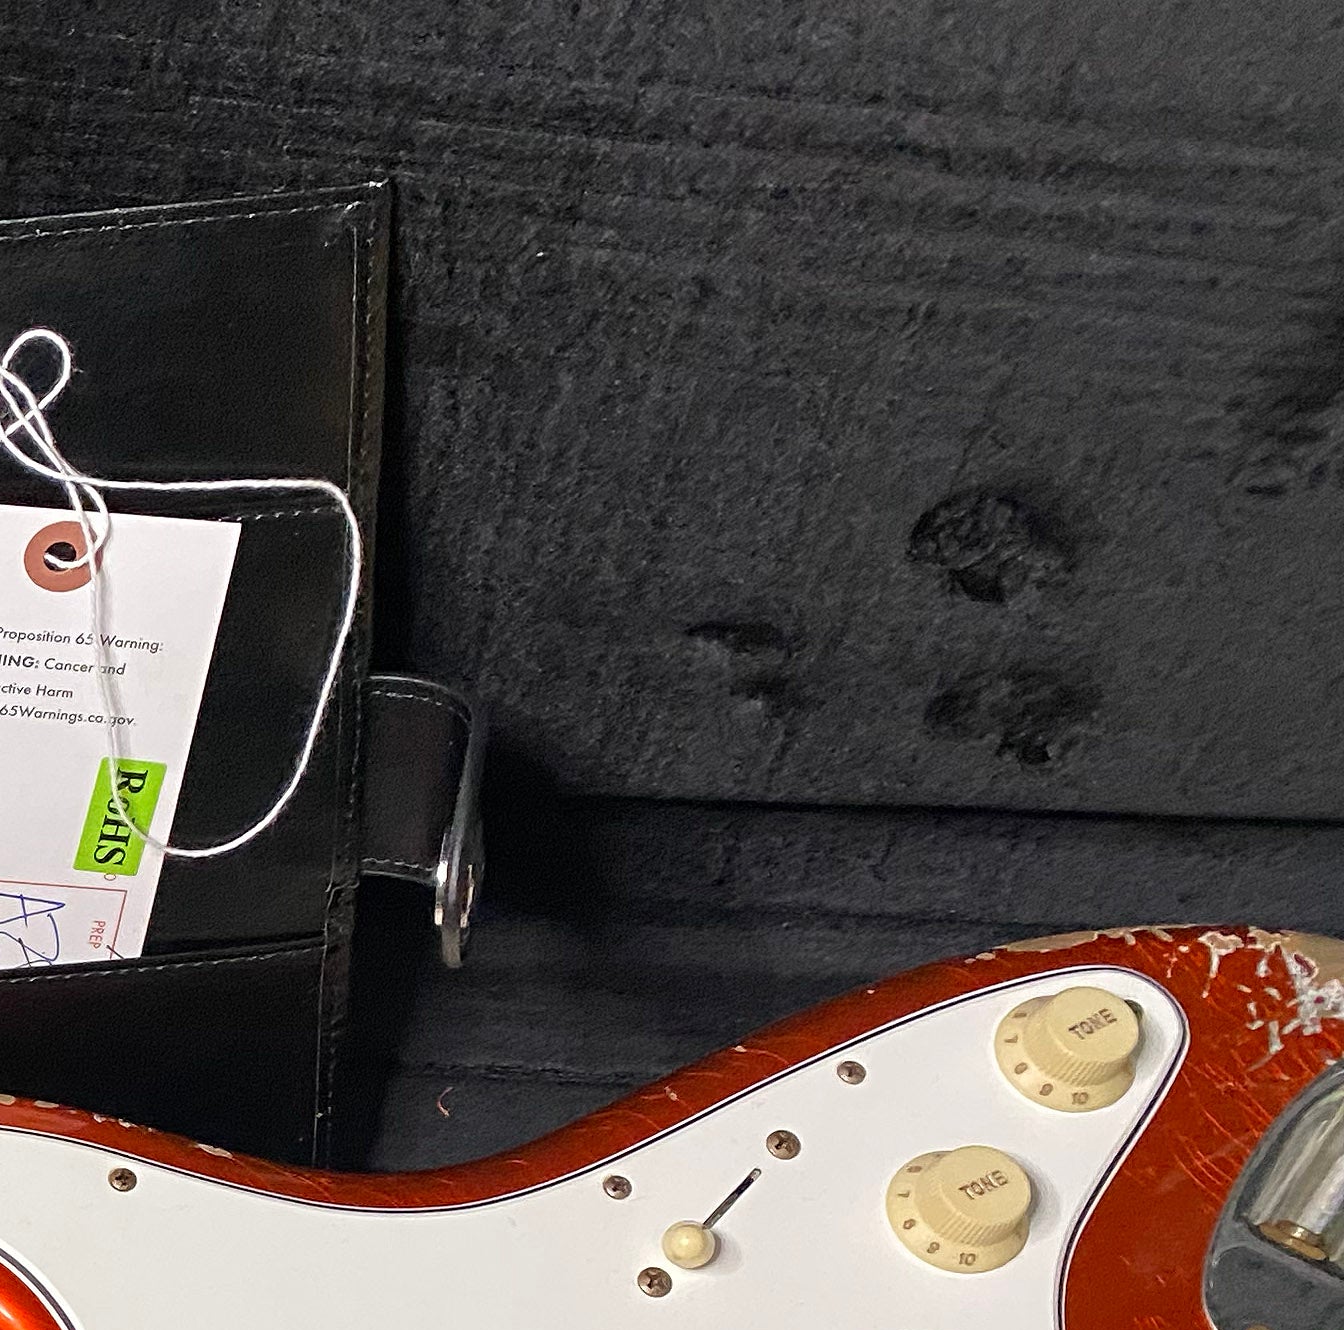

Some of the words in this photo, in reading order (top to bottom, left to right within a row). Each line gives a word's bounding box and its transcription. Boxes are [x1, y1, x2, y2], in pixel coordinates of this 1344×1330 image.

[76, 633, 93, 645] 65
[99, 633, 163, 654] Warning:
[45, 658, 93, 673] Cancer
[101, 663, 126, 675] and
[36, 684, 73, 698] Harm
[94, 768, 148, 866] RoHS
[1069, 1008, 1117, 1040] TONE
[1071, 1091, 1089, 1105] 10
[959, 1169, 1009, 1200] TONE
[959, 1252, 976, 1266] 10
